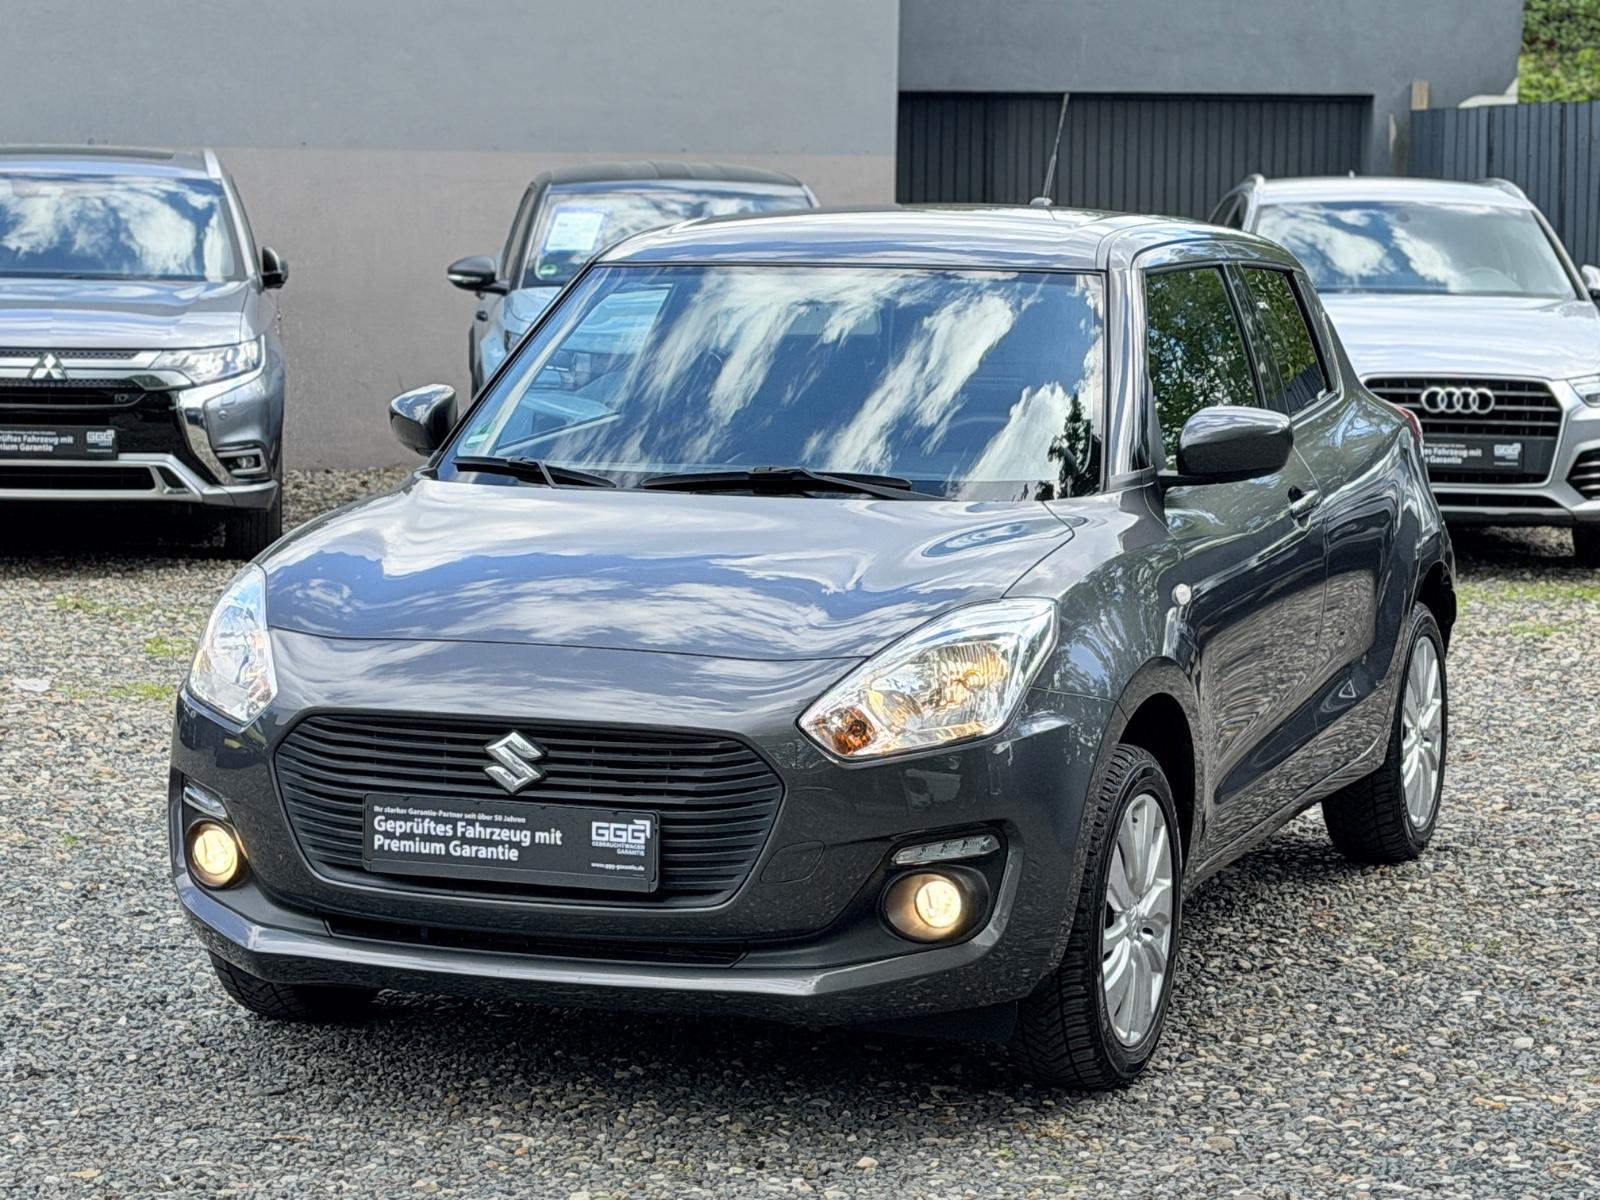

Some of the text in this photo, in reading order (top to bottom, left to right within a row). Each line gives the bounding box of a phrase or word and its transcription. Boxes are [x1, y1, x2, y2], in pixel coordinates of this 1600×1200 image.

[19, 443, 54, 452] Garantie
[22, 434, 59, 446] Fahrzeug
[60, 435, 74, 444] mit
[1468, 448, 1482, 457] mit
[384, 806, 406, 814] starker
[408, 808, 463, 819] Garantie-Partner
[477, 813, 493, 821] über
[504, 815, 526, 823] Jahren
[373, 815, 562, 847] Geprüftes Fahrzeug mit
[591, 821, 645, 844] GGG
[373, 834, 520, 861] Premium Garantie
